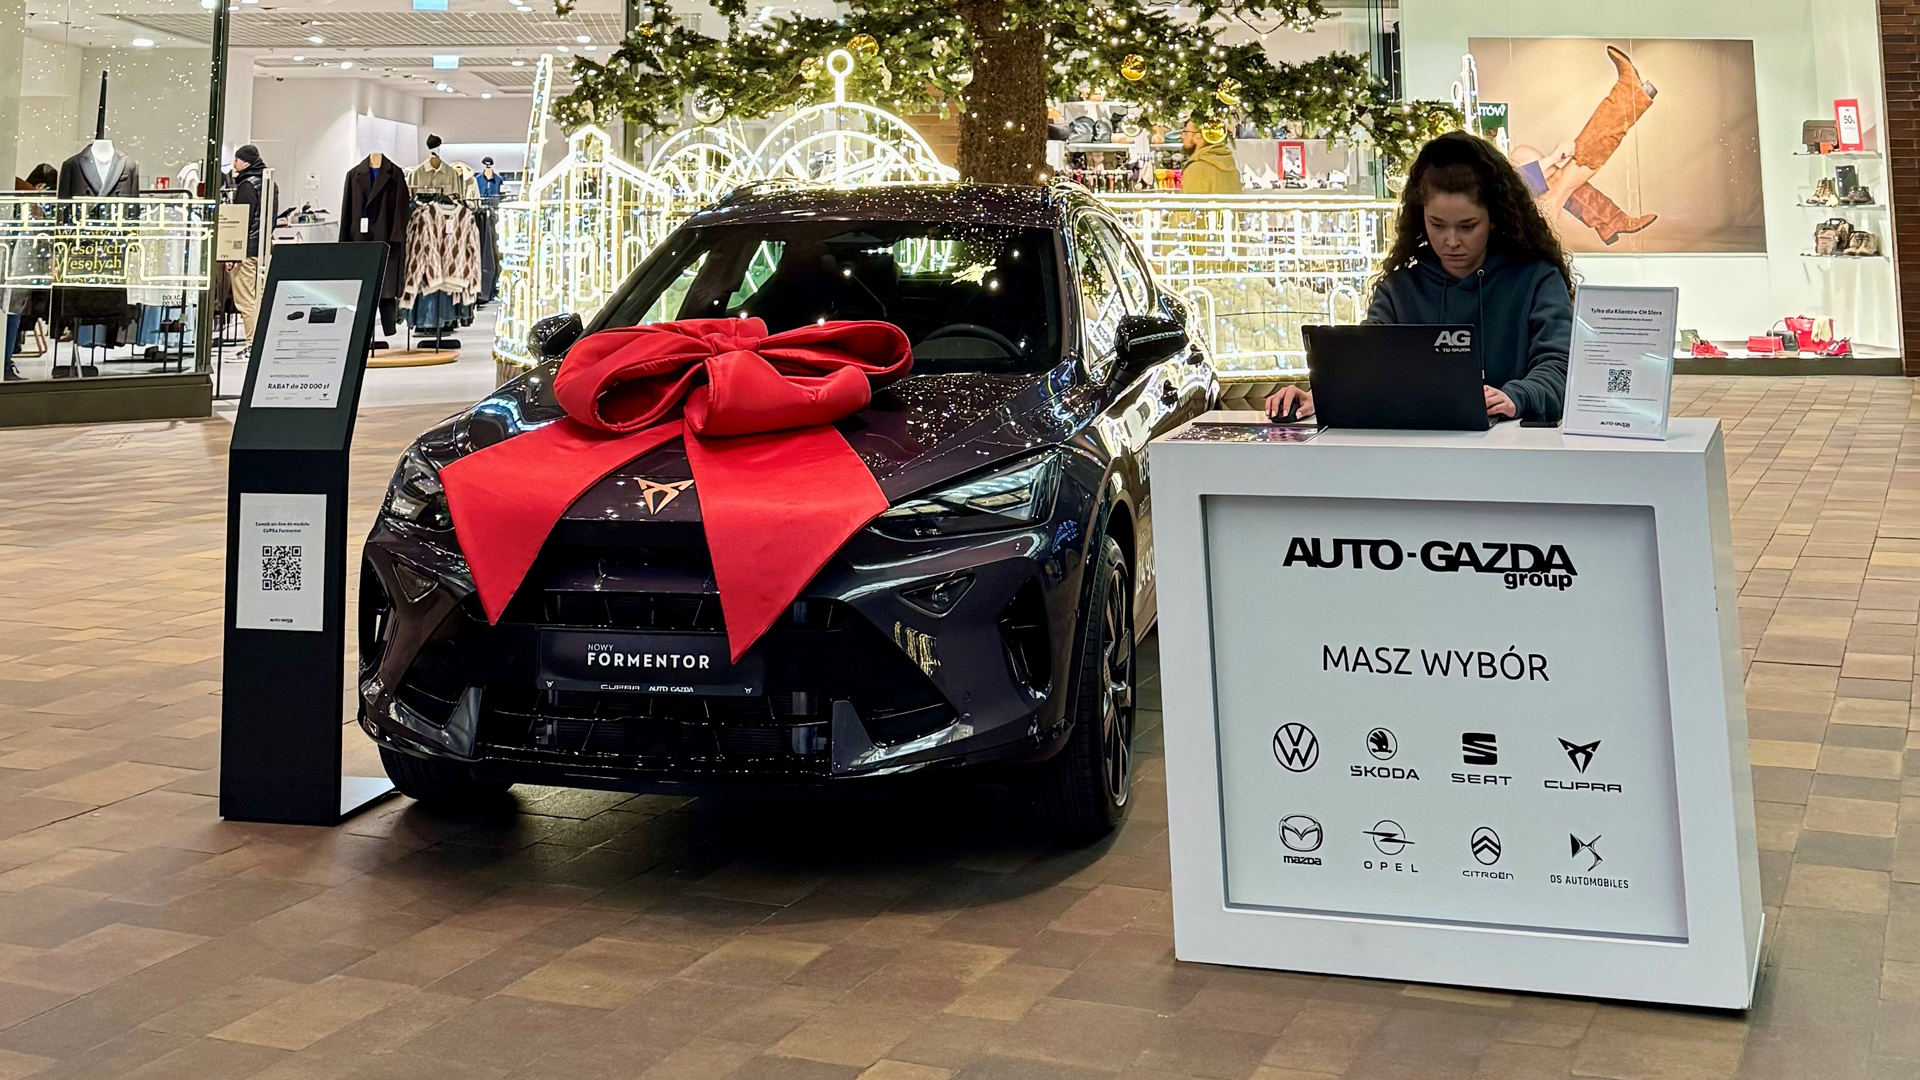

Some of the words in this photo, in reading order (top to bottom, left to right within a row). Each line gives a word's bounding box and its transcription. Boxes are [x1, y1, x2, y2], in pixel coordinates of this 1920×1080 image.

[1433, 329, 1472, 347] AG
[1282, 536, 1578, 577] AUTO-GAZDA
[1503, 570, 1573, 591] group
[587, 643, 614, 652] NOWY
[587, 652, 710, 669] FORMENTOR
[1322, 644, 1413, 675] MASZ
[1420, 645, 1550, 682] WYBÓR
[1451, 772, 1512, 786] SEAT
[1544, 780, 1623, 793] CUPRA
[1363, 860, 1419, 873] OPEL
[1550, 874, 1562, 885] DS
[1565, 875, 1629, 889] AUTOMOBILES
